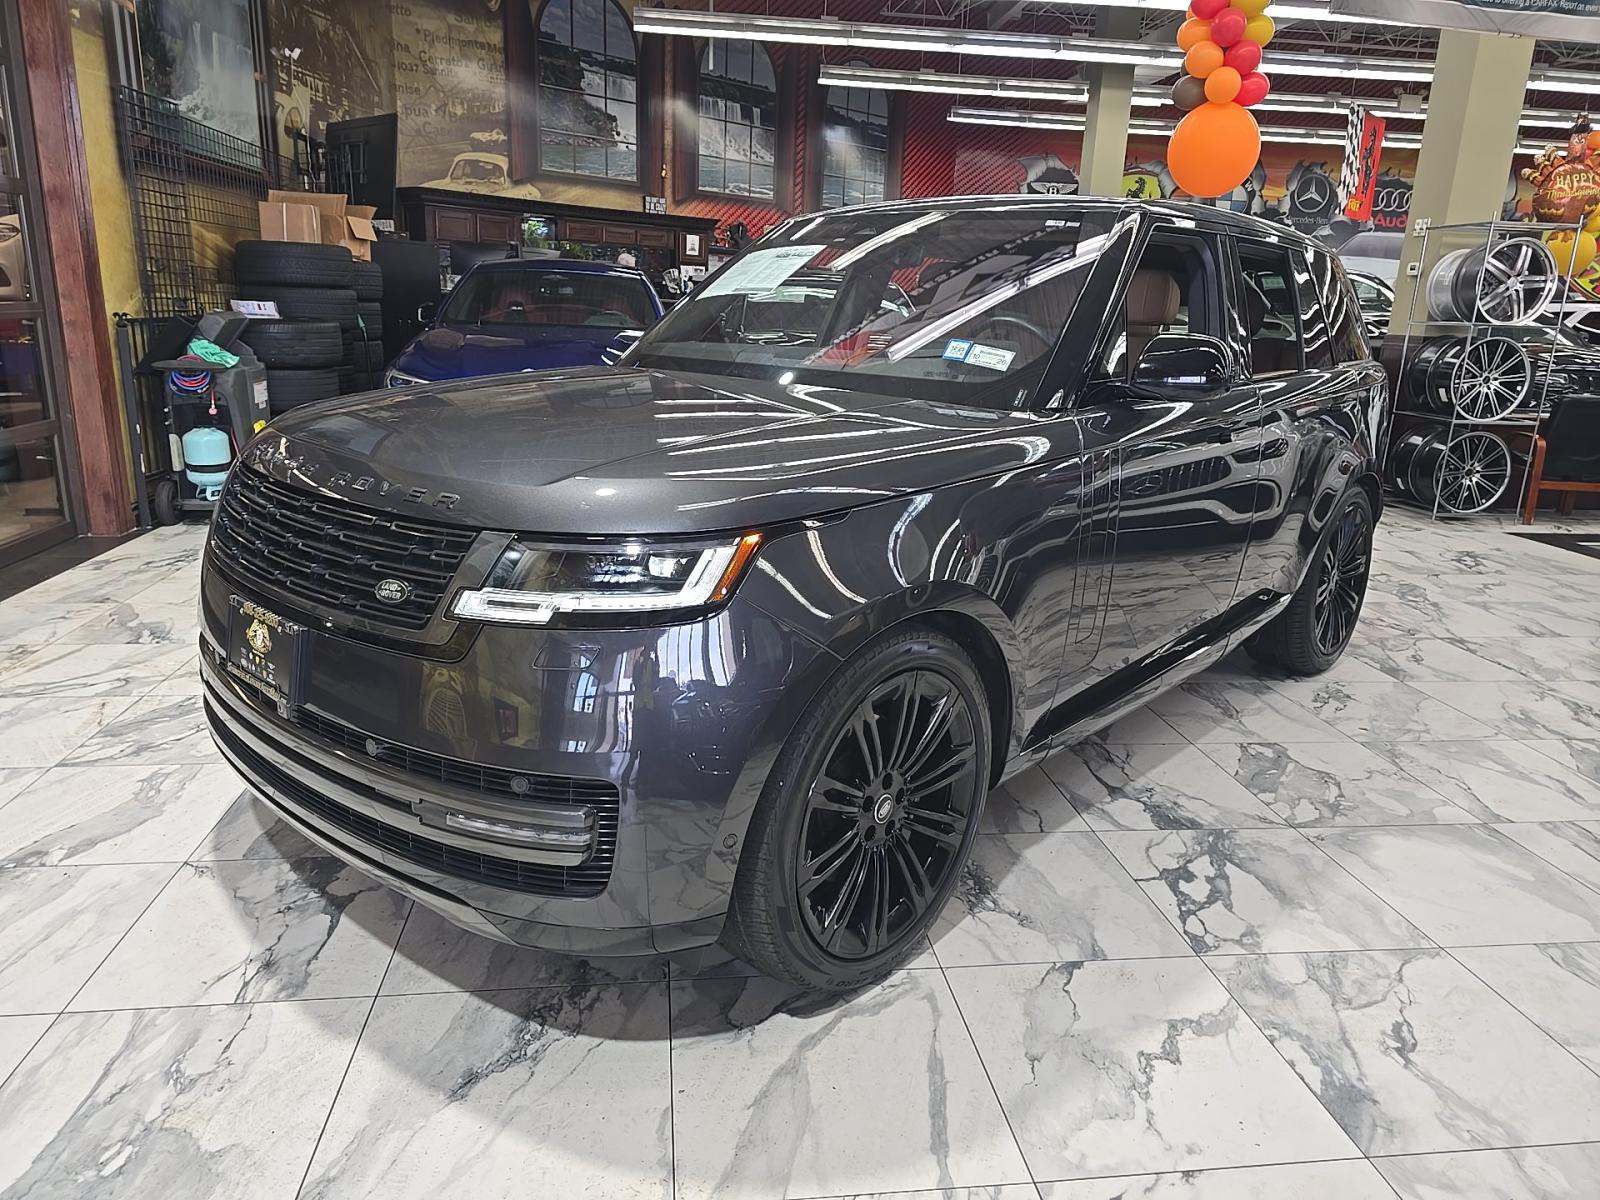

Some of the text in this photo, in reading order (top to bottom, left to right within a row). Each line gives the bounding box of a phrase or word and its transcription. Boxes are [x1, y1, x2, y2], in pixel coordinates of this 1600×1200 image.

[1556, 171, 1594, 188] HAPPY
[1374, 211, 1408, 228] Aud
[327, 470, 461, 510] ROVER
[380, 589, 401, 600] ROVER
[381, 582, 398, 591] LAND
